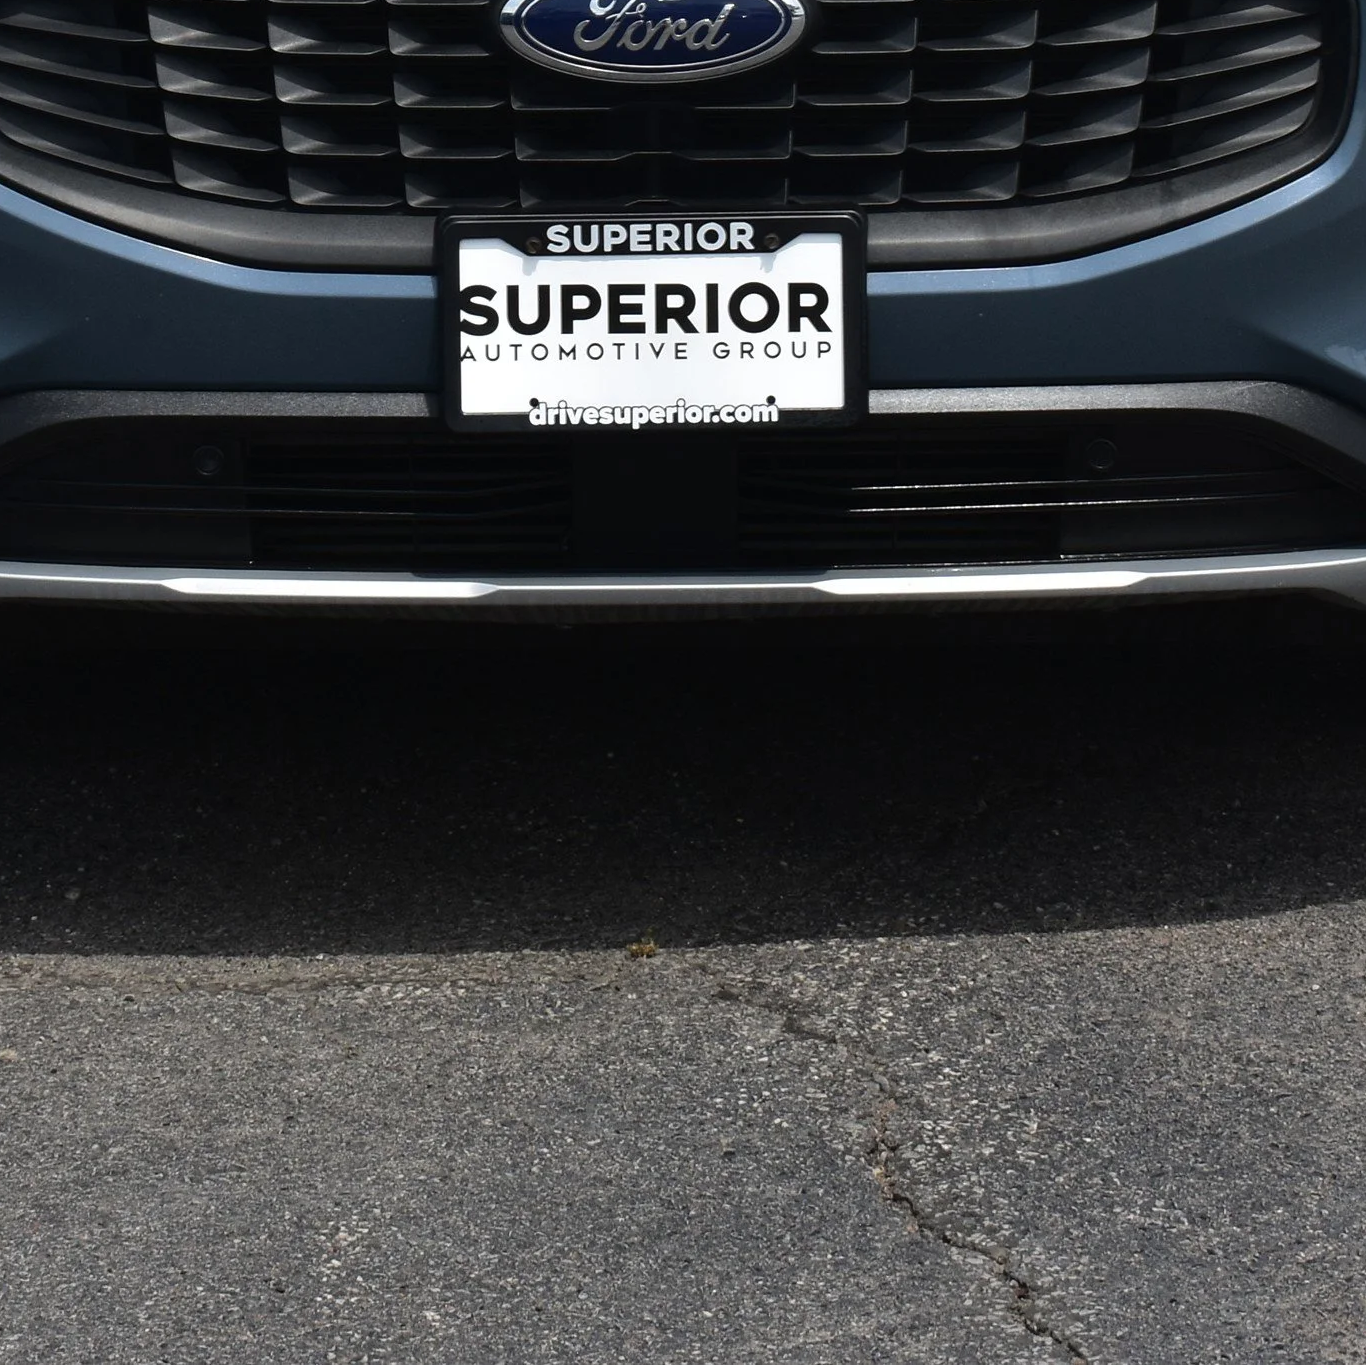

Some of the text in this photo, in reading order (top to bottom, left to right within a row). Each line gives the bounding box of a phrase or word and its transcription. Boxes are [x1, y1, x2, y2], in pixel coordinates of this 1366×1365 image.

[546, 221, 756, 254] SUPERIOR
[459, 281, 833, 336] SUPERIOR
[460, 340, 833, 363] AUTOMOTIVE GROUP
[529, 398, 780, 431] drivesuperior.com
